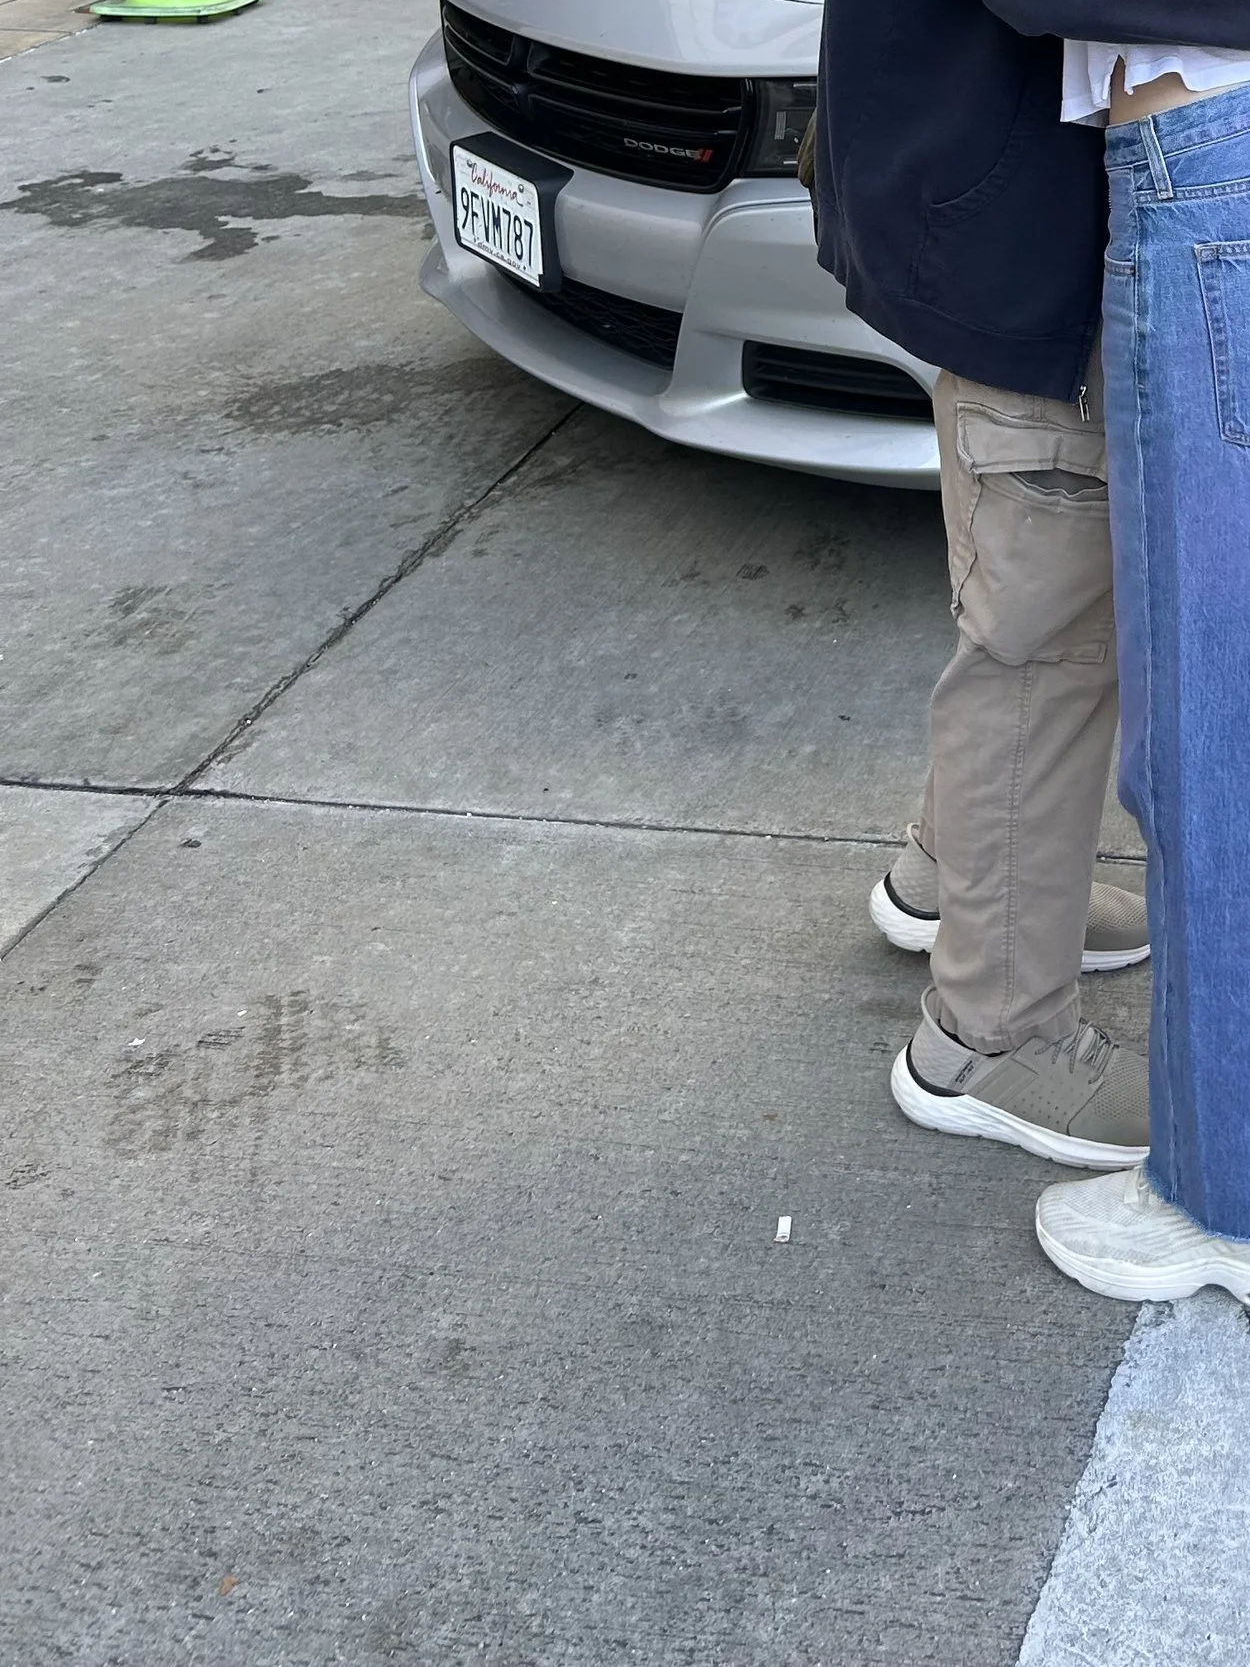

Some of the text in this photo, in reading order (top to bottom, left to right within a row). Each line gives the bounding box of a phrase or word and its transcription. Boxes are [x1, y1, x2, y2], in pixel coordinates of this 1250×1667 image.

[623, 137, 702, 160] DODGE
[471, 162, 524, 208] California
[460, 186, 534, 270] 9FVM787
